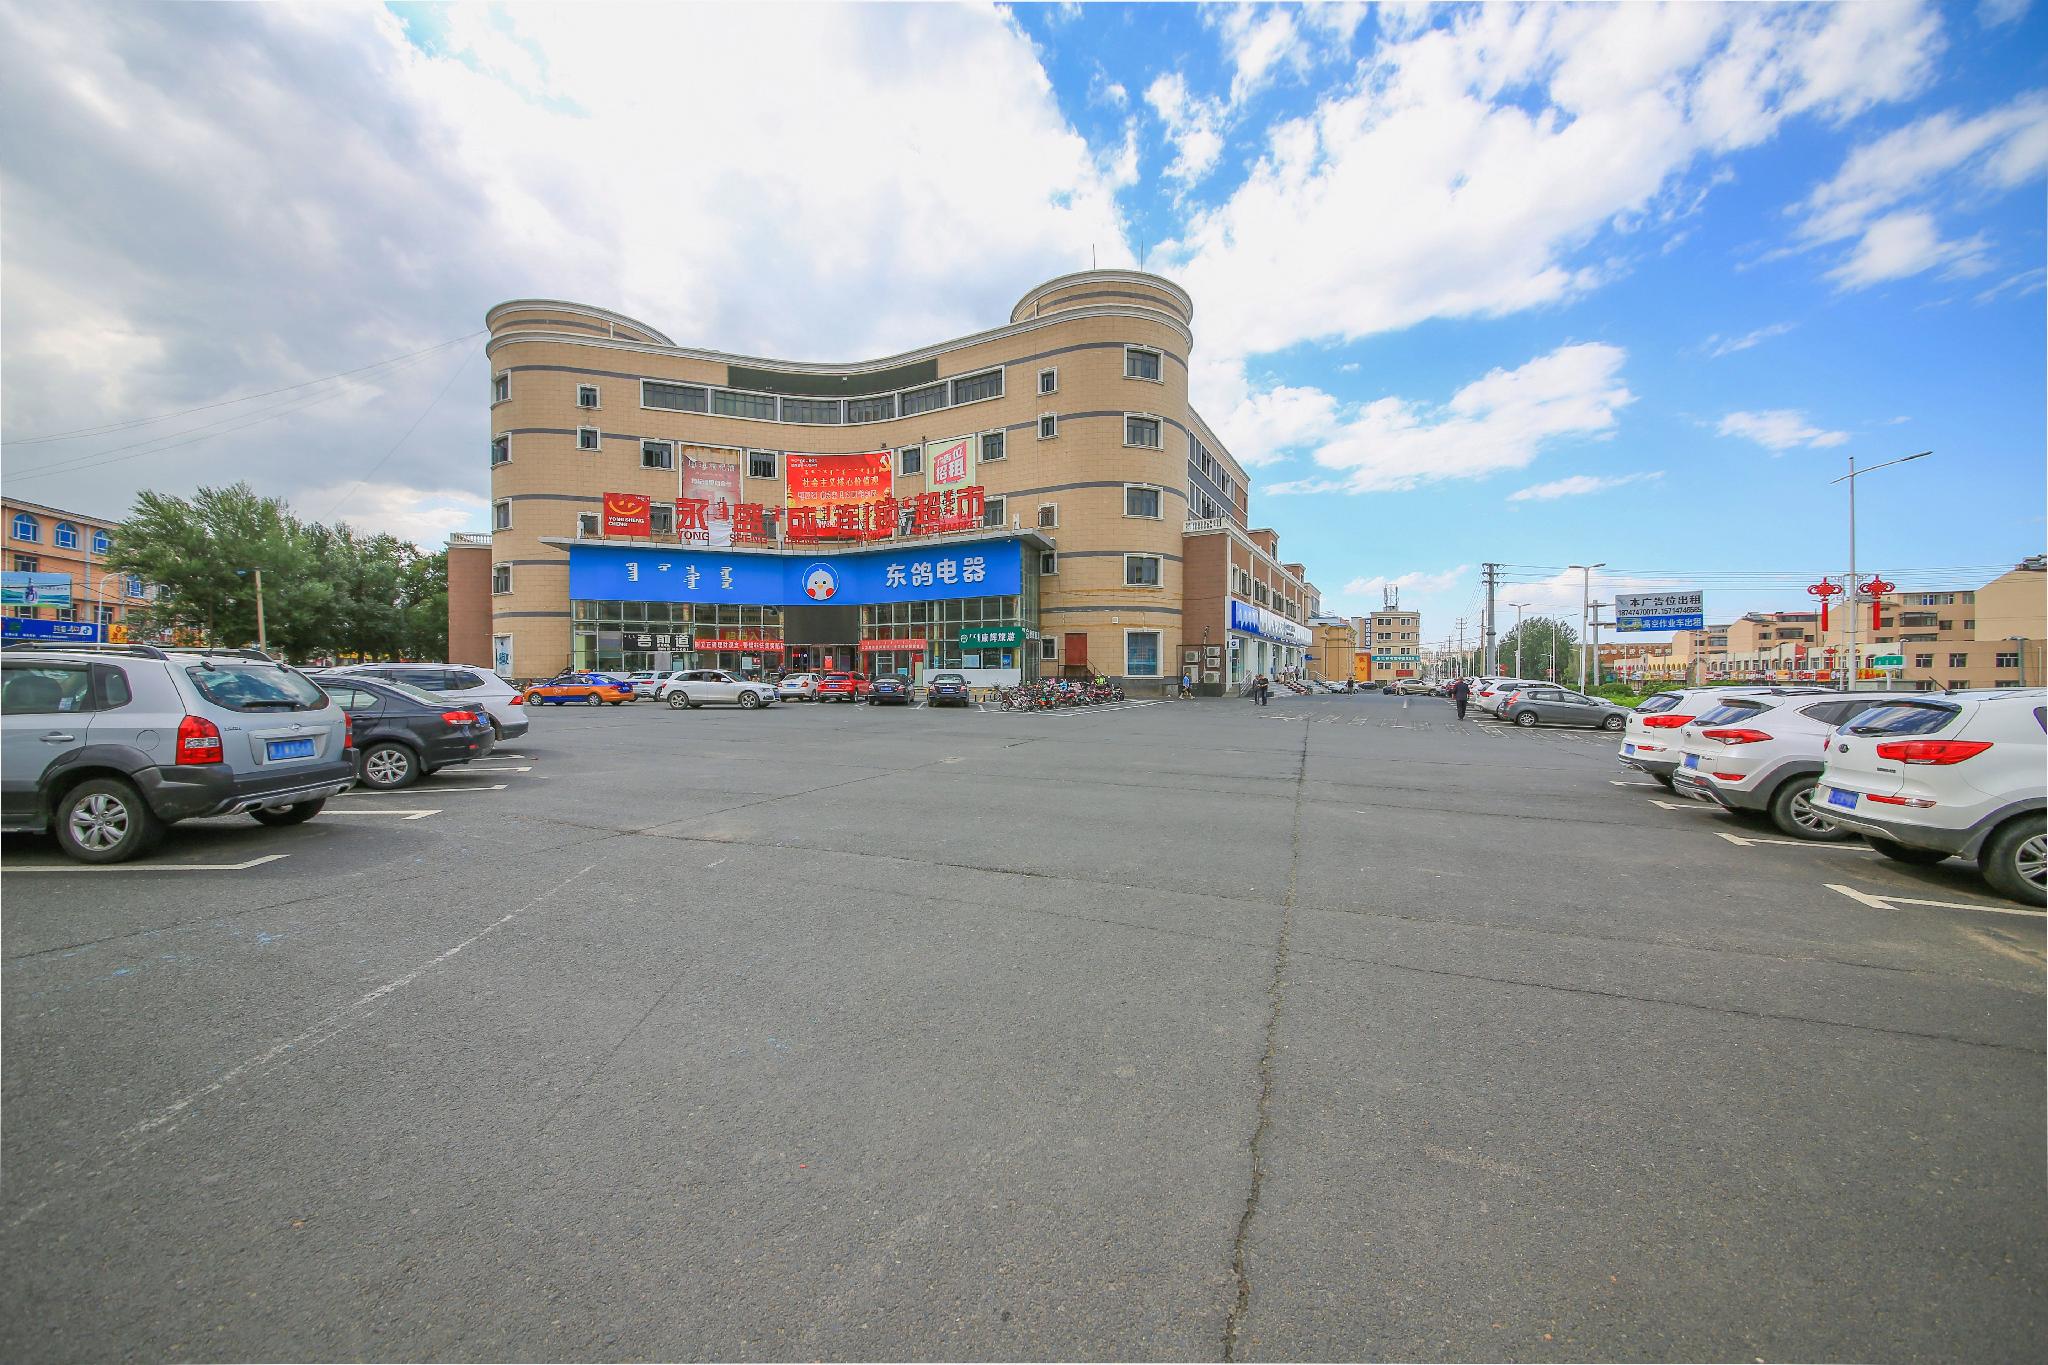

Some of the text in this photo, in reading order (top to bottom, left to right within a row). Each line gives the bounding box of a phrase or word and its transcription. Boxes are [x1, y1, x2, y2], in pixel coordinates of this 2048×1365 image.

[886, 556, 986, 589] 东鸽电器
[1630, 595, 1700, 607] 本广告位出租
[1643, 618, 1701, 628] 高空作业车出租
